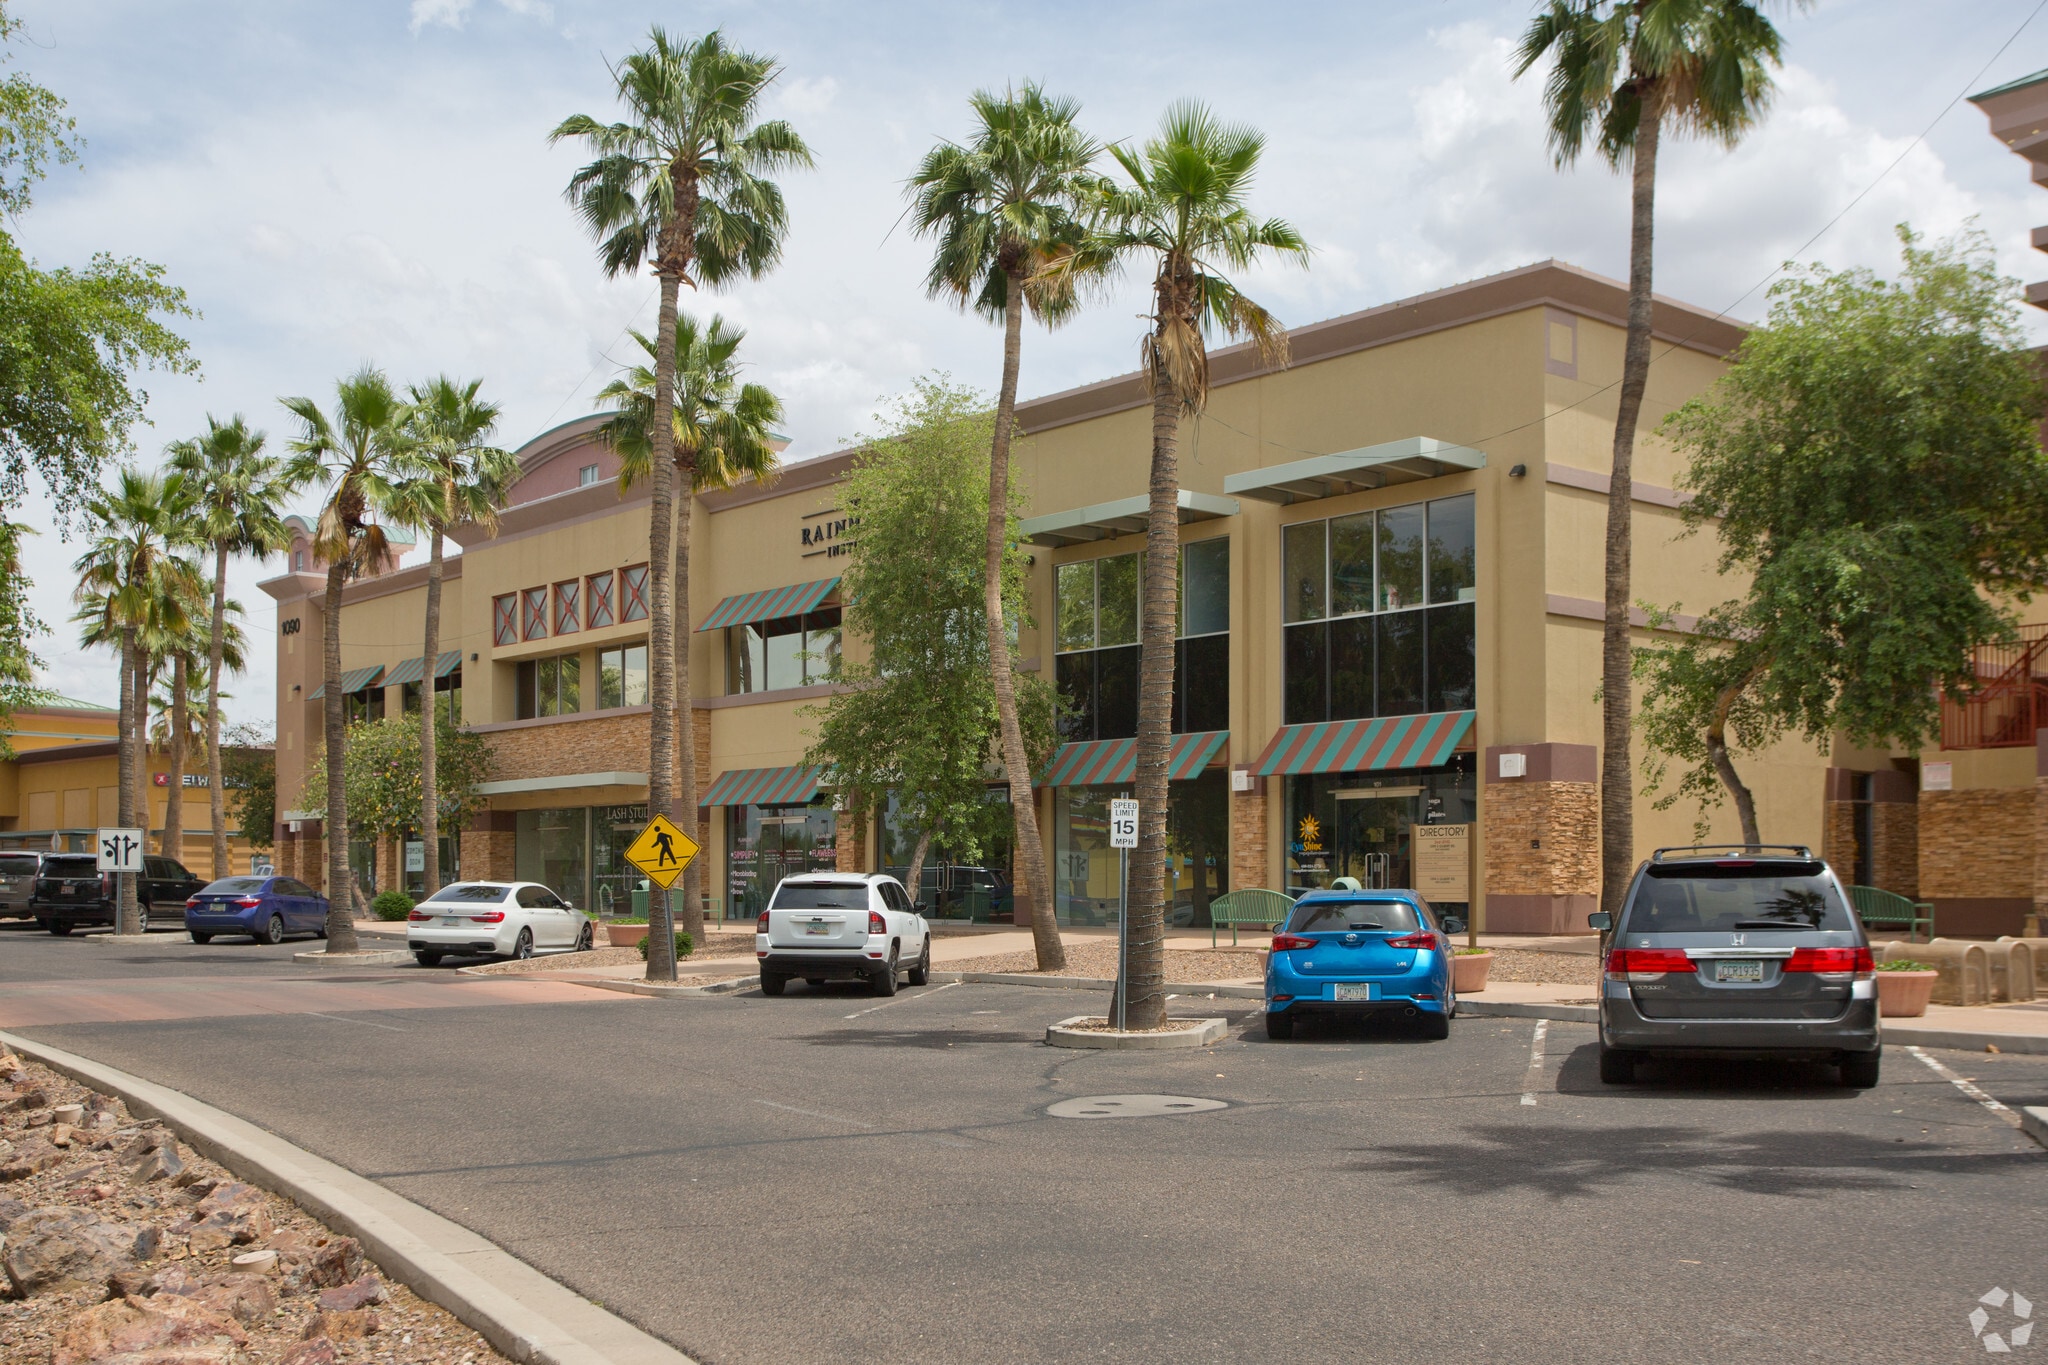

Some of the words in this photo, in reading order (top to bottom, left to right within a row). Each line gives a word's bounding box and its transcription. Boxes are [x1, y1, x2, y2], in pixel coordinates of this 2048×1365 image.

[608, 808, 626, 820] LASH
[1428, 811, 1446, 819] pilates
[1114, 820, 1134, 834] 15
[1420, 827, 1466, 836] DIRECTORY
[734, 850, 756, 860] SIMPLIFY
[812, 849, 836, 857] FLAWLESS
[1721, 965, 1760, 977] CCR1935
